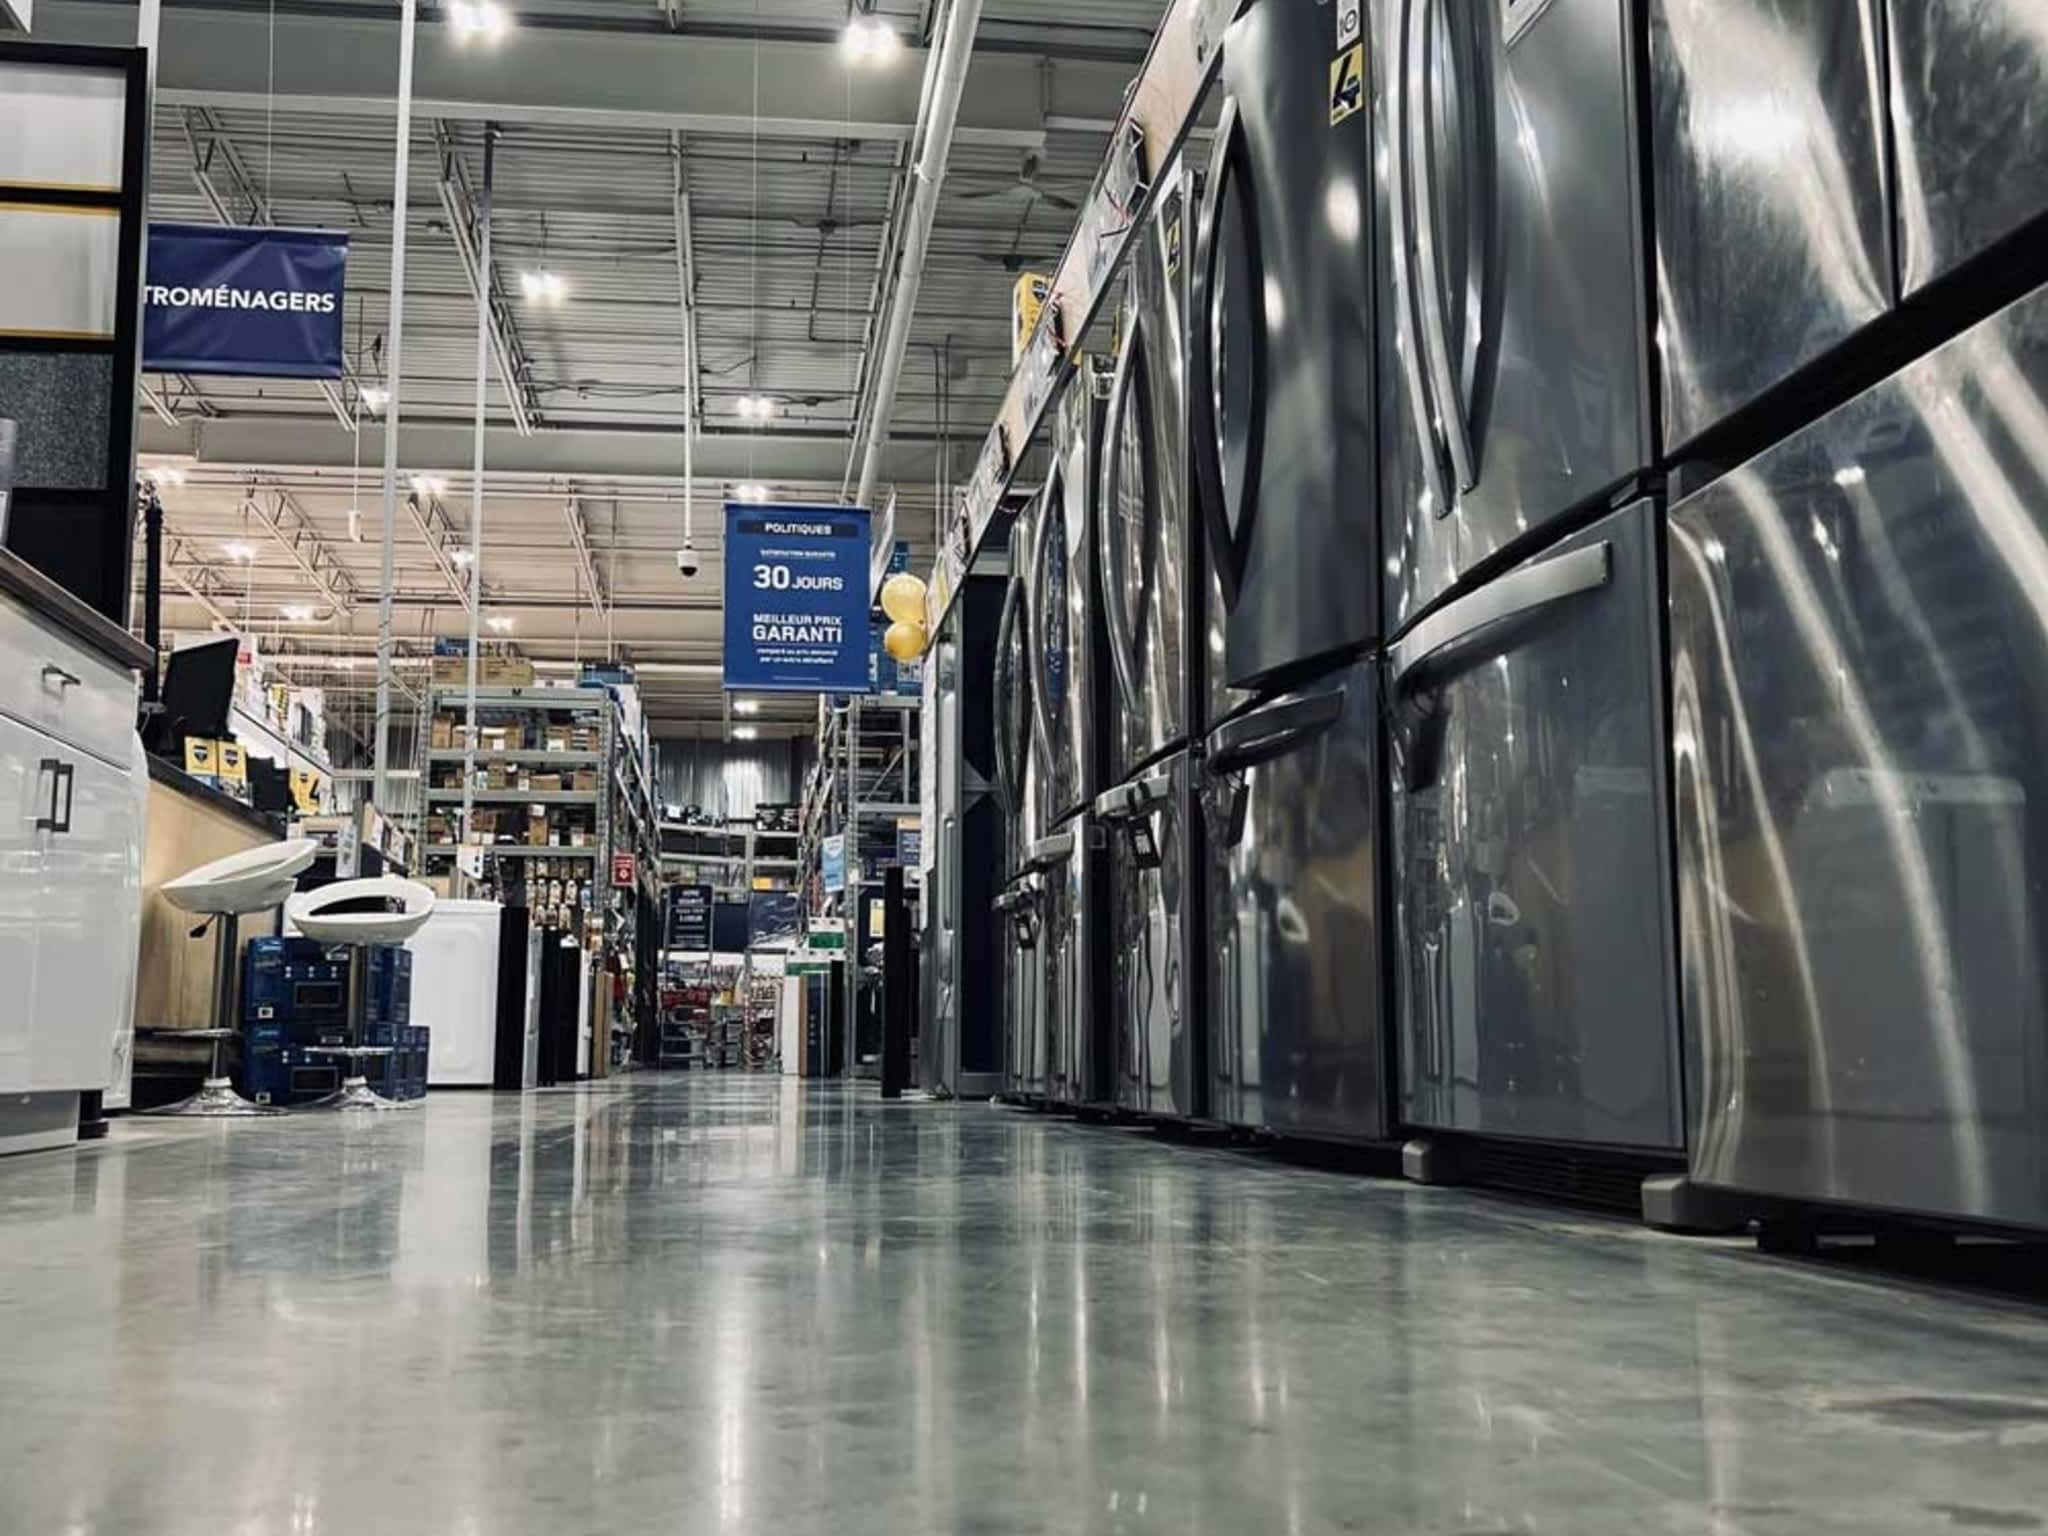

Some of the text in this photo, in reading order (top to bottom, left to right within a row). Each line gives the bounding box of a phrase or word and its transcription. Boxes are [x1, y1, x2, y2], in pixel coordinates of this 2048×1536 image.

[143, 284, 335, 312] TROMÉNAGERS
[764, 522, 833, 536] POLITIQUES
[753, 564, 843, 591] 30 JOURS
[753, 613, 842, 626] MEILLEUR PRIX
[753, 624, 842, 643] GARANTI
